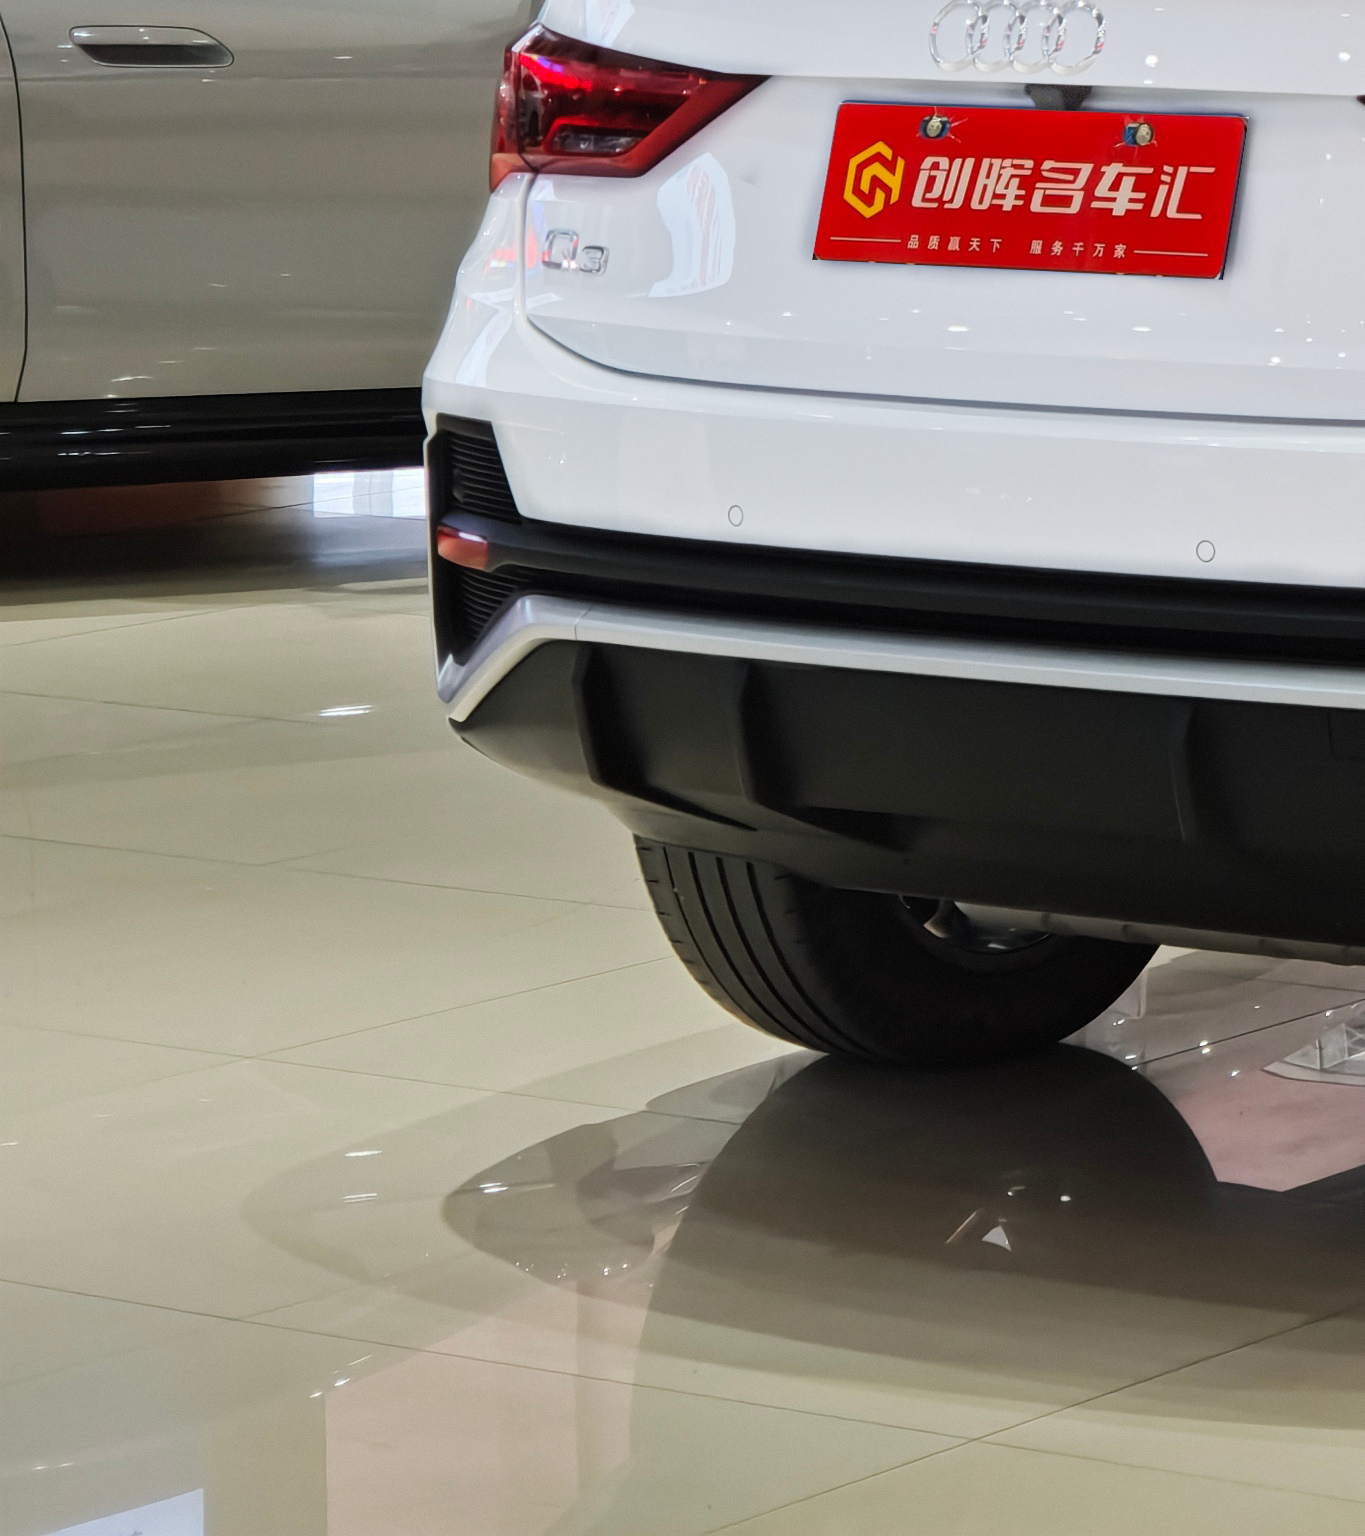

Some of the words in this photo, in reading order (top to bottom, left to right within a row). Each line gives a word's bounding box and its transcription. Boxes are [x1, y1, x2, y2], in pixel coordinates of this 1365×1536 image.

[911, 155, 1216, 220] 创晖名车汇
[541, 228, 610, 276] Q3
[907, 234, 1003, 254] 品质赢天下
[1029, 240, 1128, 259] 服务千万家
